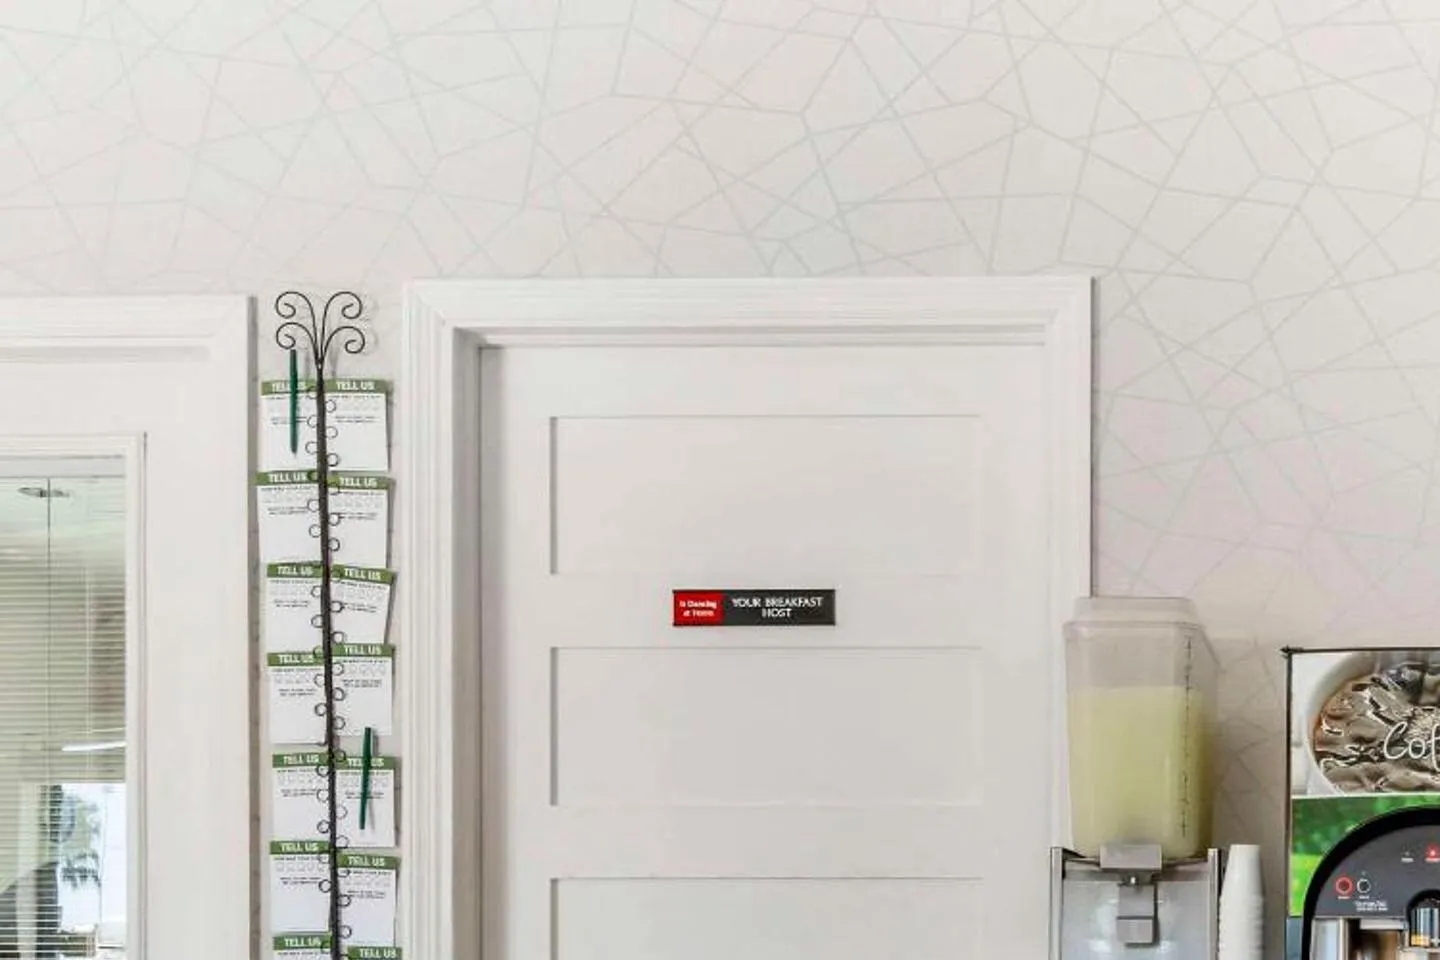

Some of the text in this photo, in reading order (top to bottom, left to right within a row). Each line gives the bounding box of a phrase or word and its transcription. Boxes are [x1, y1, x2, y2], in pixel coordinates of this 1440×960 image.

[336, 382, 375, 390] TELL US
[269, 473, 291, 482] TELL
[339, 478, 378, 487] TELL US
[277, 566, 313, 575] TELL US
[344, 568, 381, 580] TELL US
[732, 597, 824, 607] YOUR BREAKFAST
[762, 608, 792, 618] HOST
[344, 644, 382, 655] TELL US
[278, 654, 299, 664] TELL
[283, 754, 319, 765] TELL US
[281, 843, 319, 852] TELL US
[348, 856, 385, 867] TELL US
[284, 938, 306, 947] TELL
[360, 949, 397, 958] TELL US
